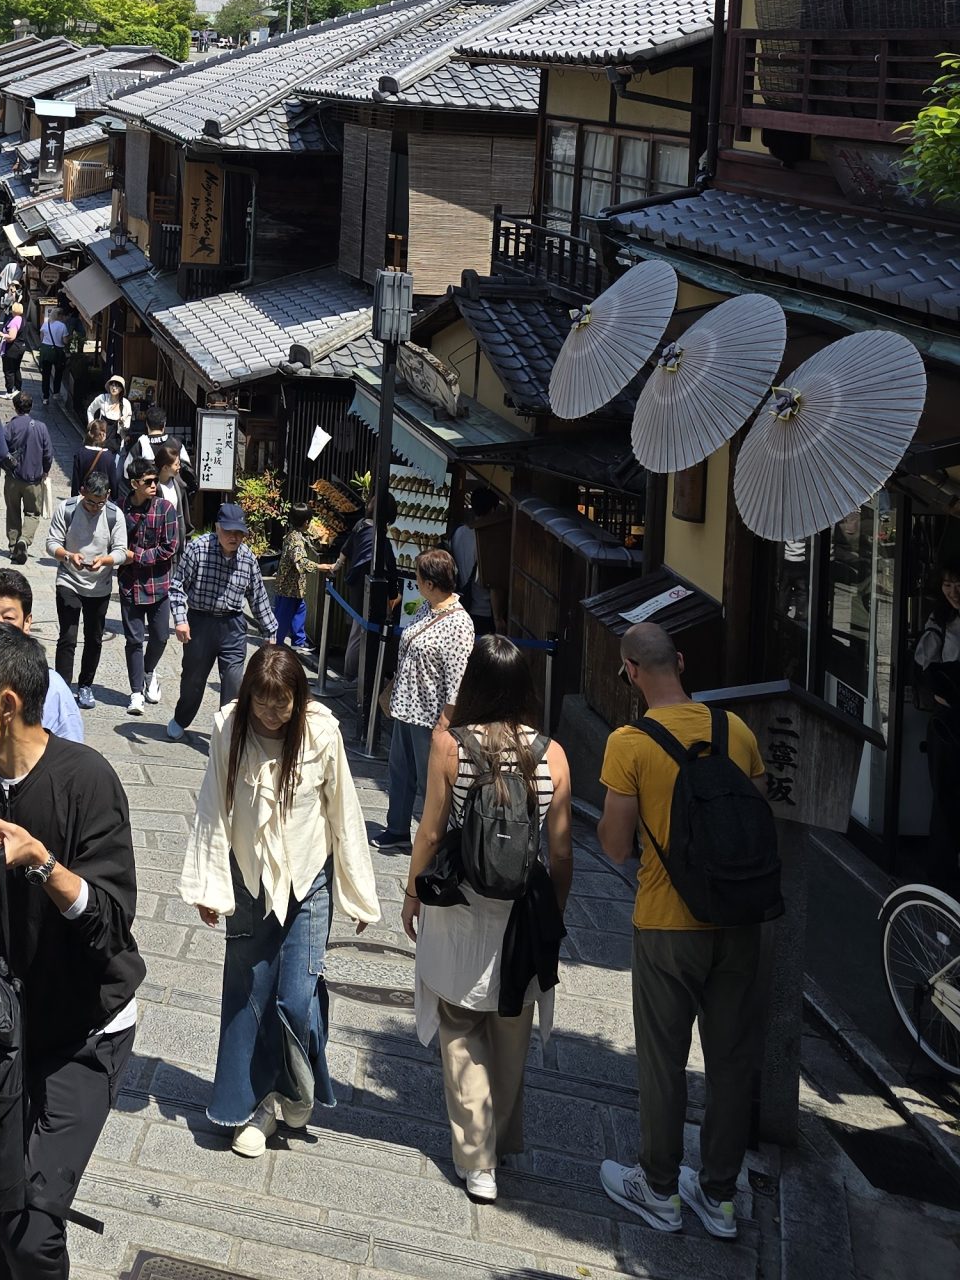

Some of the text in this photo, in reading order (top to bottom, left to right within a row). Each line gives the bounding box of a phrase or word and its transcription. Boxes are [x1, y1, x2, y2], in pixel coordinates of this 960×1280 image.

[225, 422, 233, 449] そば処
[202, 452, 213, 482] ふたば
[767, 717, 800, 806] 二寧坂
